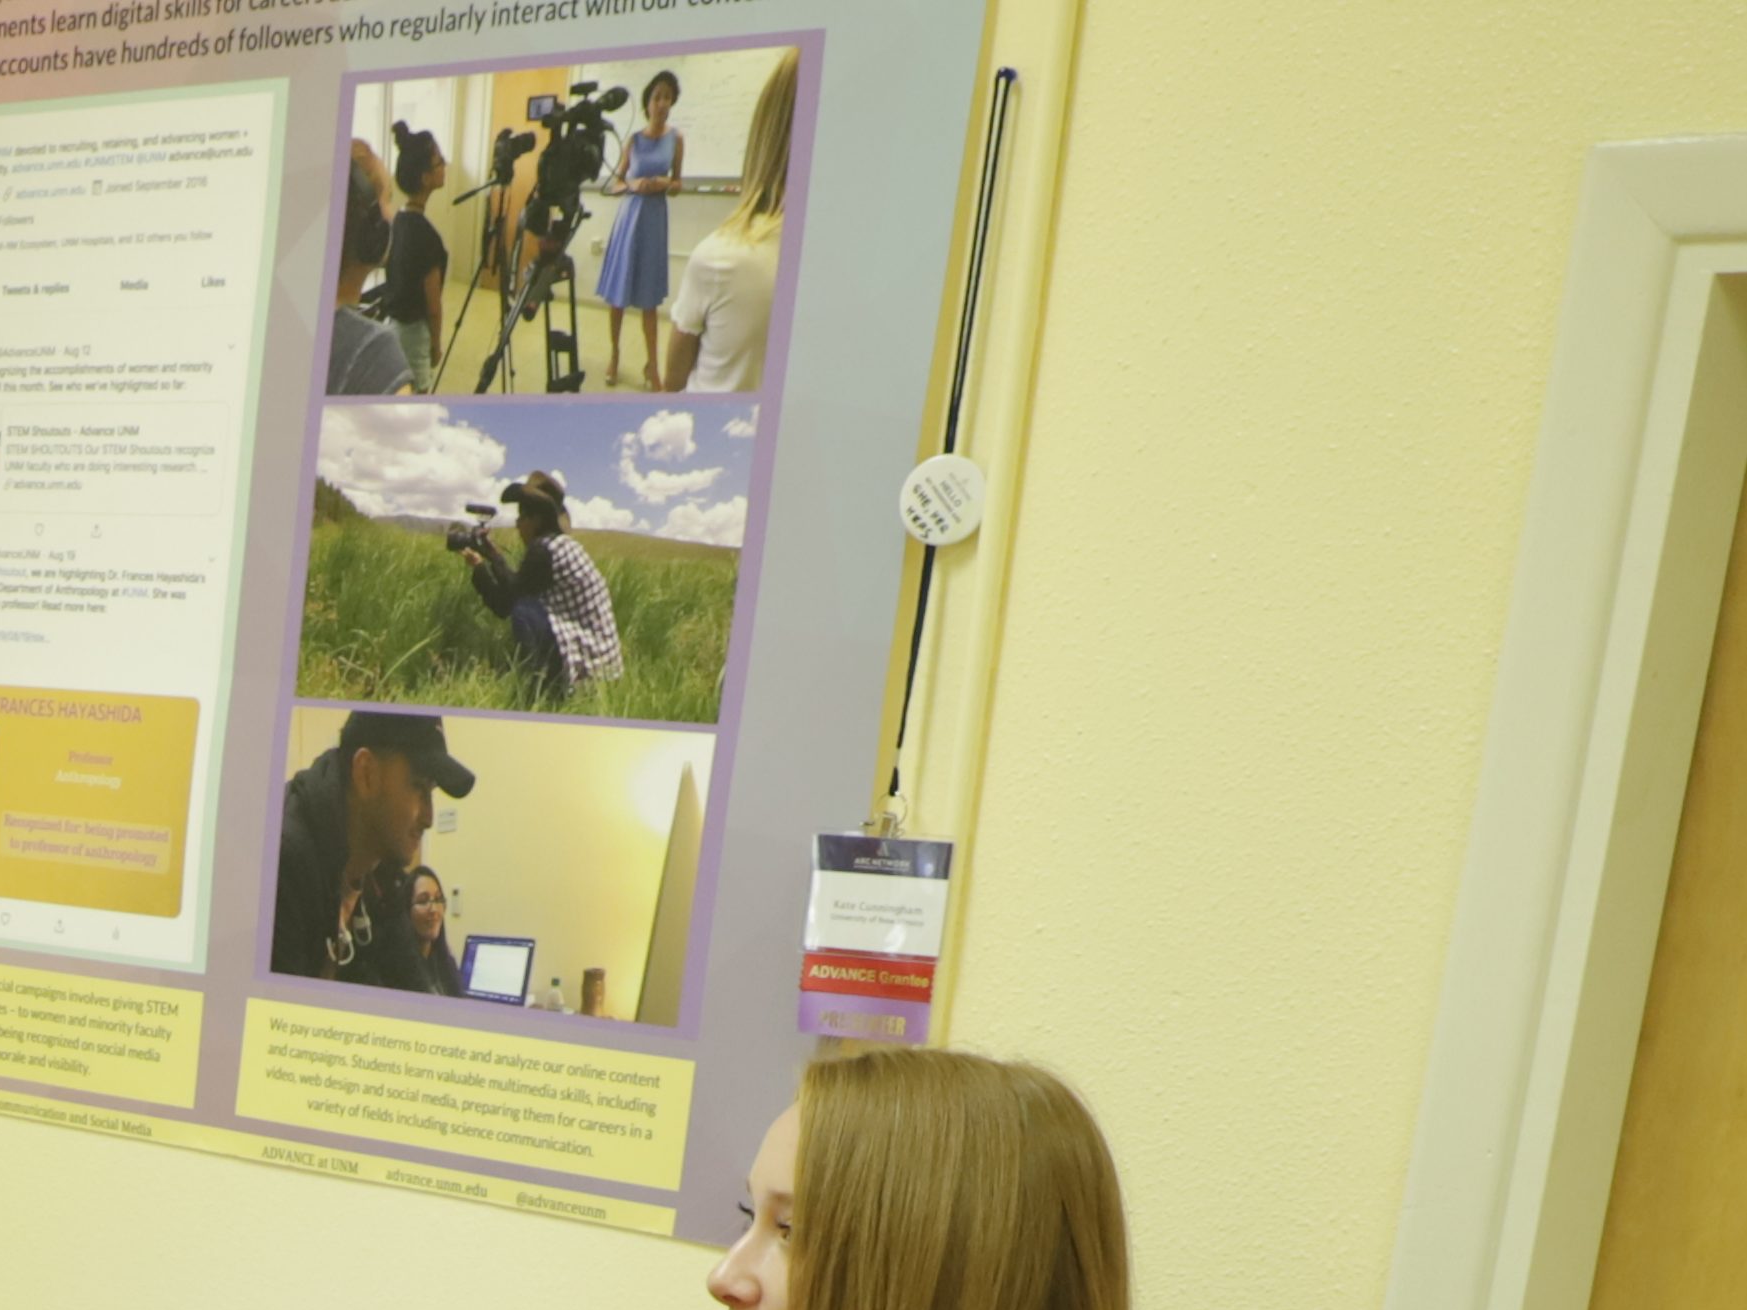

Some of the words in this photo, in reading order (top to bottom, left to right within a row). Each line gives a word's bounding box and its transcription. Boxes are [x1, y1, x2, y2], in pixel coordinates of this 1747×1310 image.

[50, 18, 96, 34] learn
[101, 7, 159, 30] digital
[164, 2, 211, 22] skills
[72, 49, 115, 68] have
[120, 37, 208, 63] hundreds
[213, 34, 233, 54] of
[237, 28, 333, 52] followers
[338, 20, 384, 41] who
[389, 9, 486, 38] regularly
[490, 0, 580, 26] interact
[57, 701, 142, 723] HAYASHIDA
[809, 965, 875, 983] ADVANCE
[879, 971, 929, 988] Grantee
[15, 984, 66, 1001] campaigns
[68, 989, 110, 1006] involves
[112, 996, 144, 1014] giving
[146, 1000, 179, 1016] STEM
[17, 1006, 28, 1018] to
[30, 1011, 66, 1024] women
[67, 1015, 86, 1027] and
[88, 1017, 132, 1037] minority
[134, 1023, 172, 1042] faculty
[26, 1033, 79, 1049] recognized
[81, 1041, 94, 1052] on
[96, 1043, 126, 1057] social
[127, 1048, 161, 1062] media
[269, 1018, 287, 1033] We
[289, 1024, 309, 1040] pay
[311, 1026, 369, 1046] undergrad
[371, 1033, 411, 1052] interns
[413, 1040, 426, 1054] to
[428, 1045, 466, 1060] create
[468, 1050, 491, 1064] and
[494, 1054, 539, 1072] analyze
[542, 1062, 563, 1075] our
[566, 1064, 606, 1081] online
[608, 1072, 660, 1089] content
[27, 1055, 46, 1067] and
[47, 1057, 90, 1077] visibility.
[267, 1044, 287, 1058] and
[289, 1049, 350, 1068] campaigns.
[352, 1055, 401, 1075] Students
[404, 1063, 434, 1080] learn
[436, 1070, 485, 1088] valuable
[488, 1079, 557, 1099] multimedia
[559, 1088, 594, 1107] skills,
[596, 1092, 657, 1118] including
[265, 1067, 296, 1086] video,
[298, 1074, 321, 1088] web
[323, 1075, 359, 1096] design
[362, 1084, 384, 1098] and
[386, 1088, 418, 1103] social
[421, 1094, 458, 1112] media,
[461, 1101, 520, 1122] preparing
[522, 1108, 554, 1125] them
[557, 1113, 575, 1129] for
[577, 1119, 626, 1136] careers
[628, 1124, 642, 1139] in
[644, 1130, 652, 1141] a
[68, 1112, 88, 1125] and
[89, 1114, 119, 1131] Social
[121, 1119, 151, 1137] Media
[306, 1099, 345, 1118] variety
[347, 1104, 359, 1118] of
[361, 1105, 393, 1123] fields
[396, 1111, 448, 1135] including
[450, 1122, 493, 1140] science
[496, 1131, 594, 1157] communication.
[262, 1146, 314, 1167] ADVANCE
[316, 1157, 328, 1169] at
[330, 1158, 359, 1174] UNM
[385, 1169, 487, 1197] advance.unm.edu
[516, 1194, 606, 1218] @advanceunm
